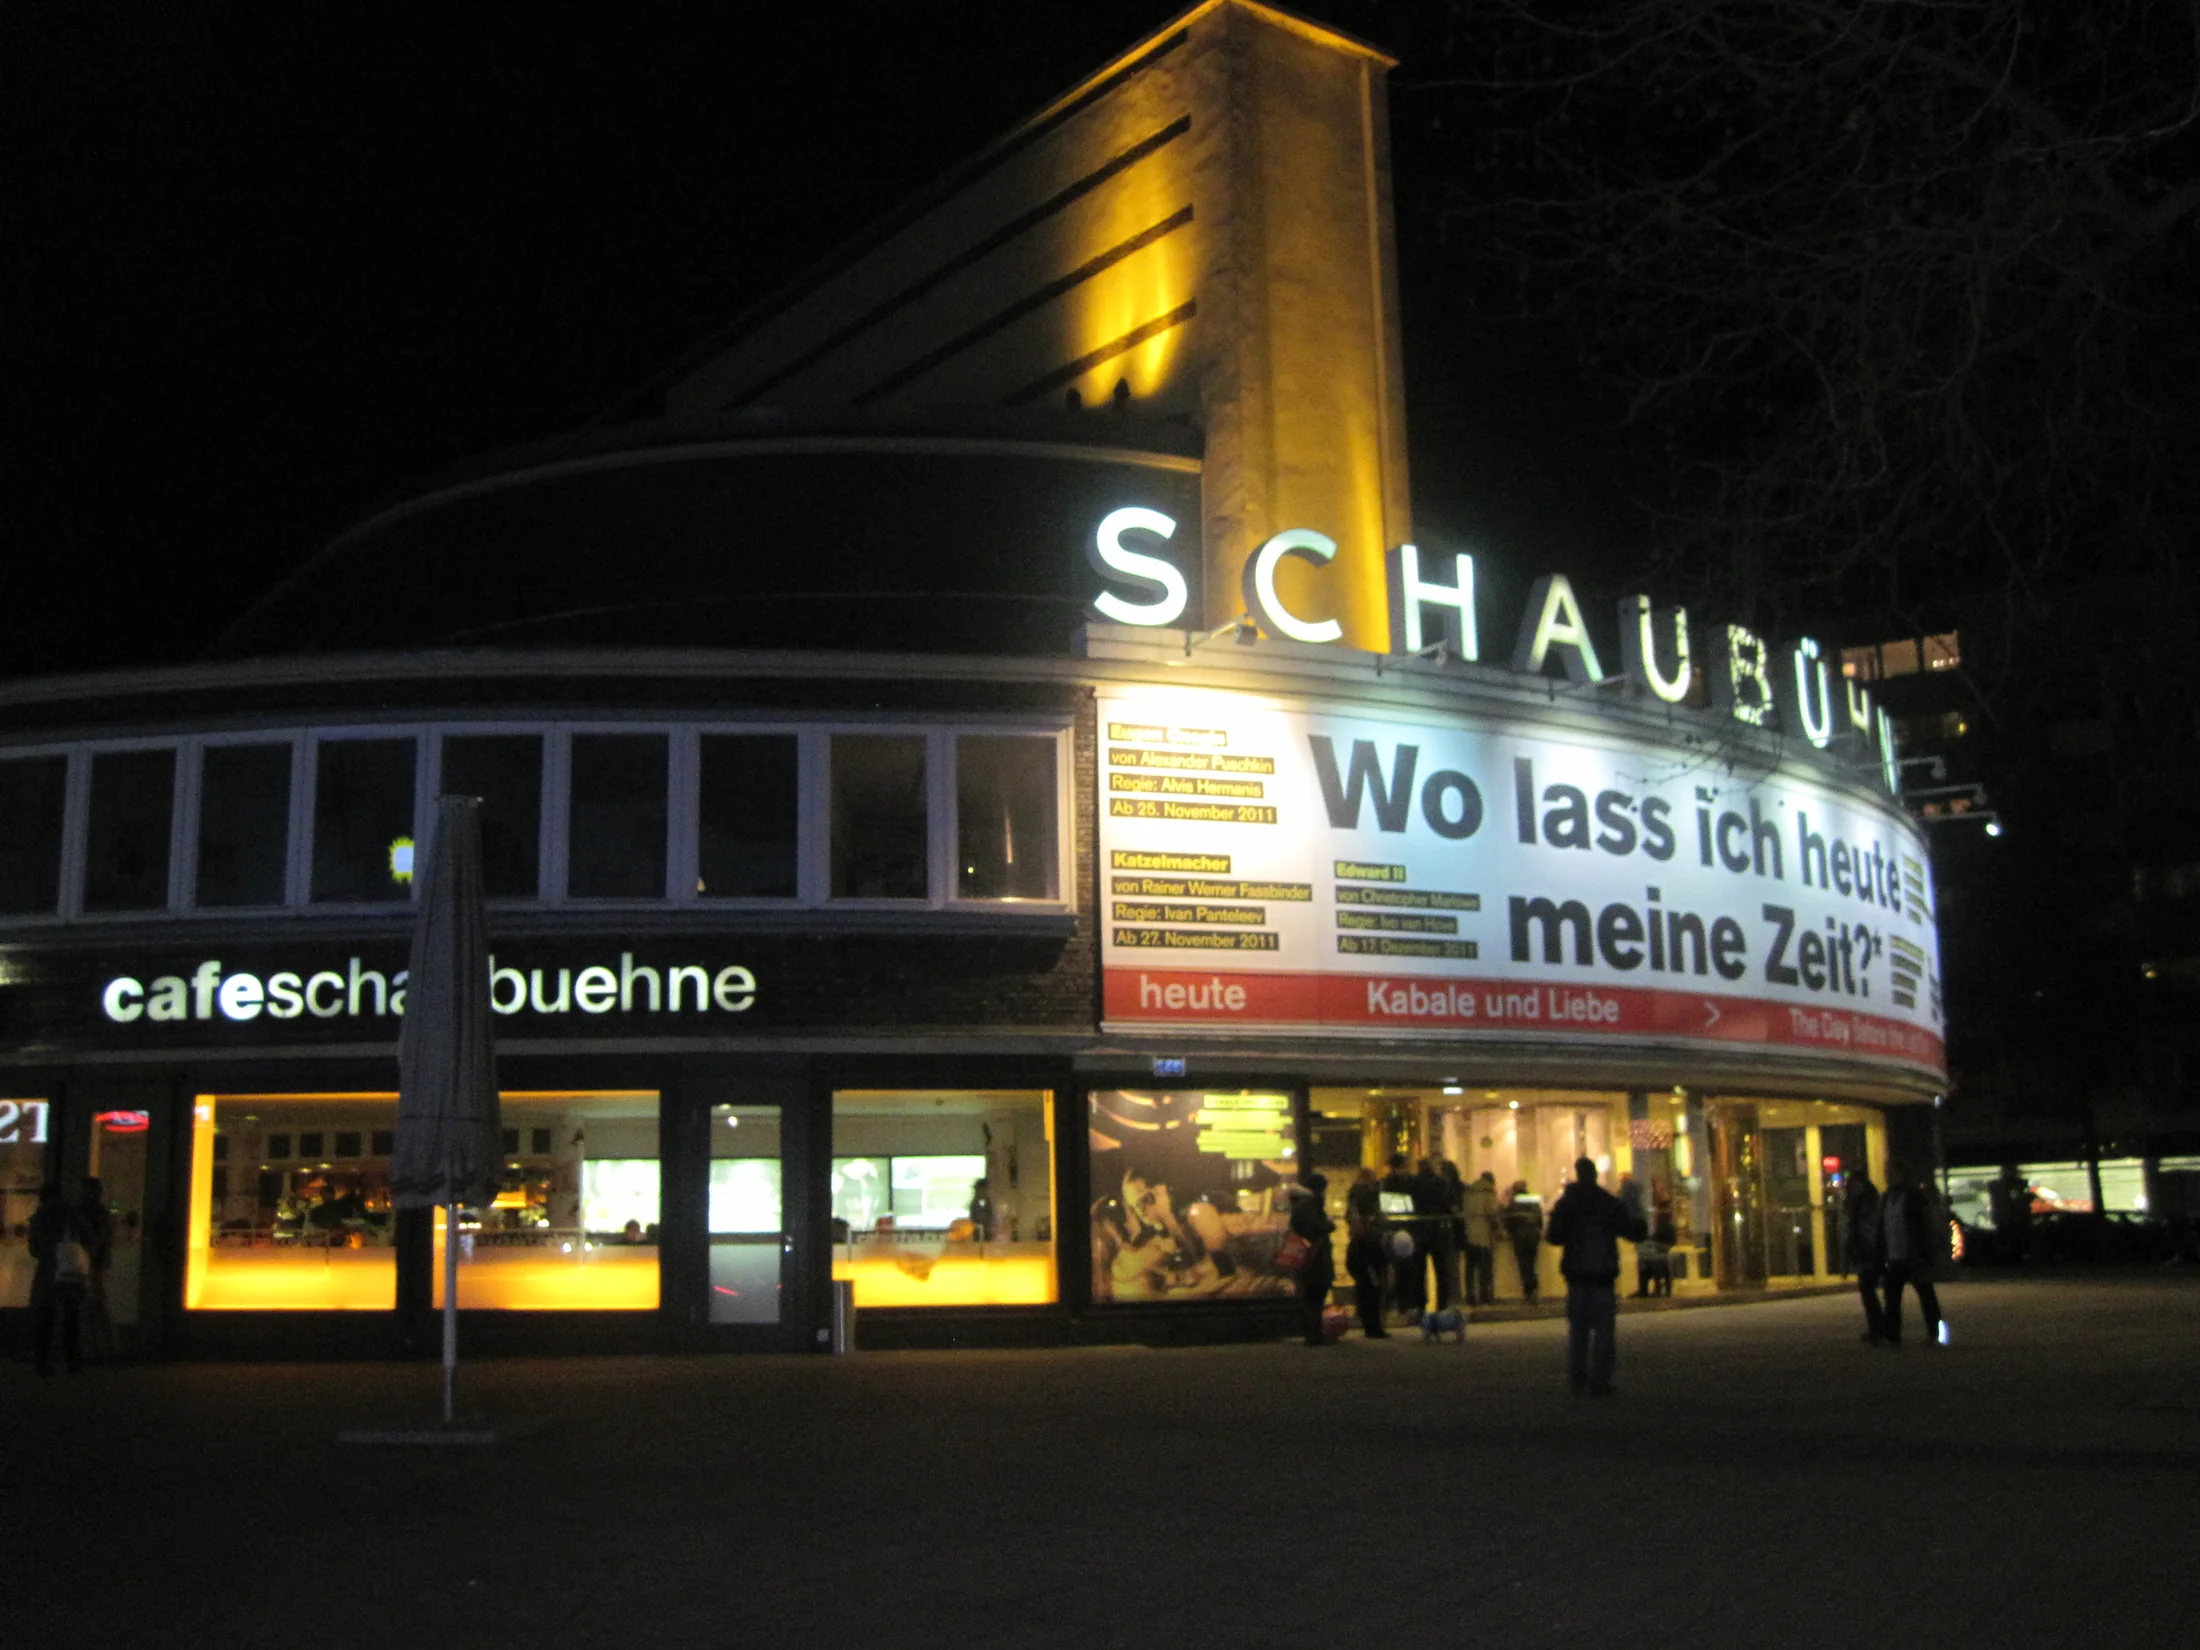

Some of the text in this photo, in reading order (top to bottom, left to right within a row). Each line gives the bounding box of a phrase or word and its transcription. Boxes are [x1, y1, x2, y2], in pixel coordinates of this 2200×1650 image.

[1111, 751, 1273, 773] von Alexander Puschkin
[1112, 776, 1262, 798] Regie: Alvis Hermanis
[1112, 801, 1273, 822] Ab 25. November 2011
[1308, 734, 1483, 840] Wo
[1513, 757, 1676, 861] lass
[1695, 786, 1784, 881] ich
[1797, 811, 1903, 913] heute
[1114, 853, 1229, 872] Katzelmacher
[1115, 881, 1139, 893] von
[1142, 879, 1185, 895] Rainer
[1188, 881, 1236, 897] Werner
[1115, 904, 1160, 921] Regie:
[1165, 905, 1193, 920] Ivan
[1116, 931, 1275, 949] Ab 27. November 2011
[1507, 887, 1747, 980] meine
[1139, 974, 1246, 1011] heute
[1366, 981, 1620, 1022] Kabale und Liebe
